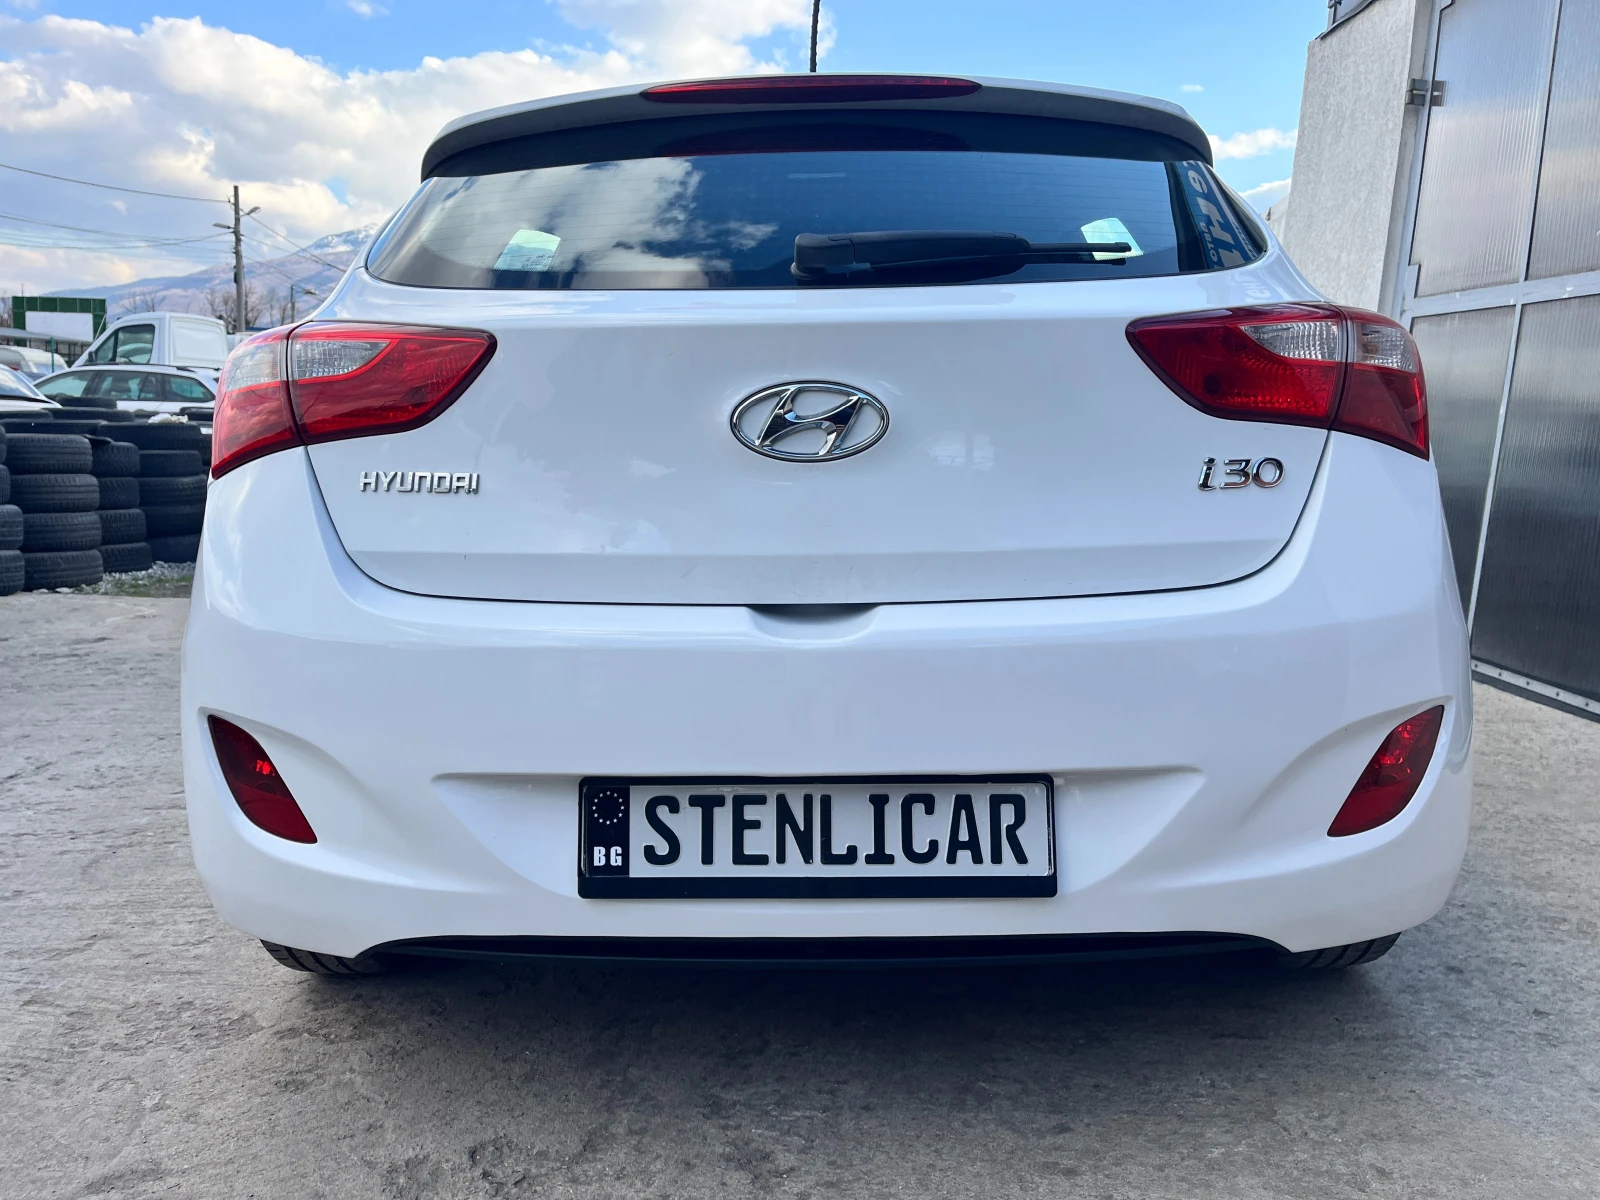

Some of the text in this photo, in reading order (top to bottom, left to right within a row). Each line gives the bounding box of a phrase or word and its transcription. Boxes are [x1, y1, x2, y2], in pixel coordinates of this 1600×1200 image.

[360, 471, 479, 494] HYUNDAI
[1198, 456, 1285, 491] i30
[643, 793, 1029, 866] STENLICAR
[592, 845, 624, 867] BG
